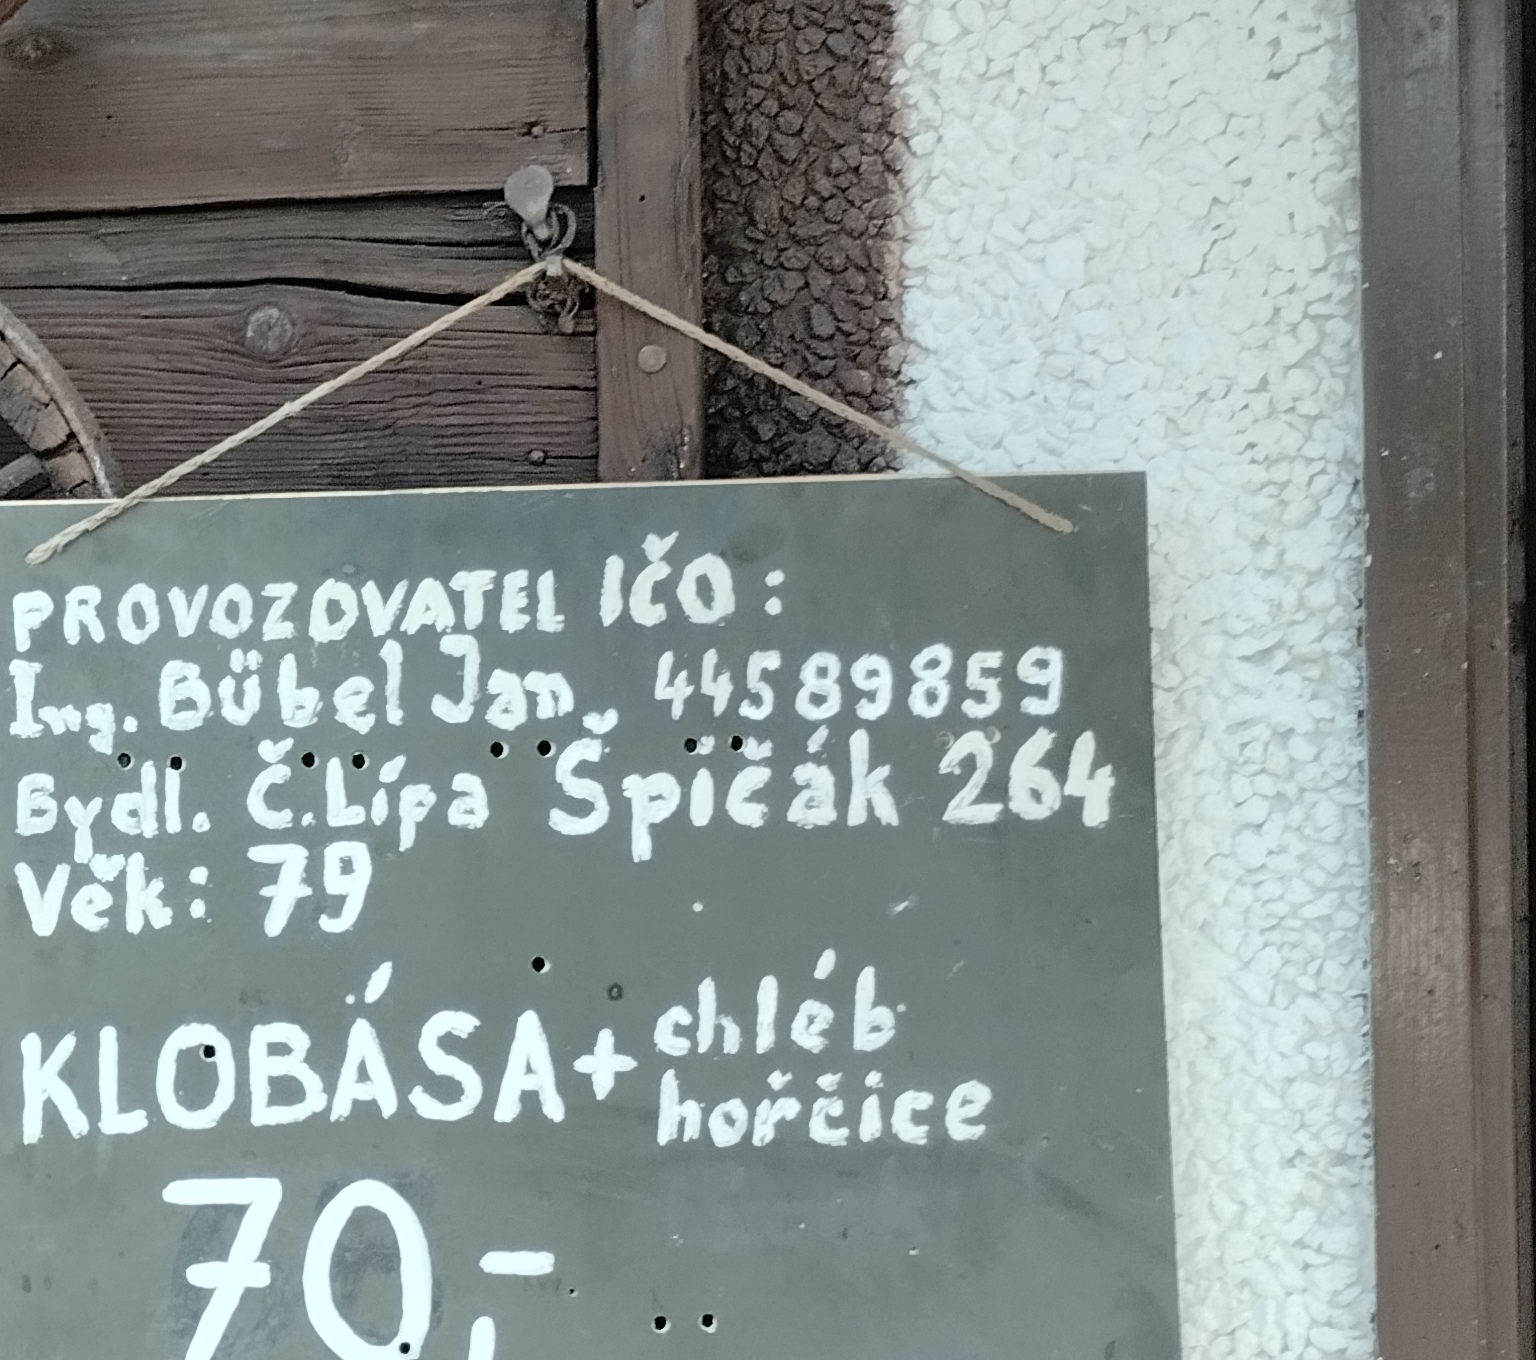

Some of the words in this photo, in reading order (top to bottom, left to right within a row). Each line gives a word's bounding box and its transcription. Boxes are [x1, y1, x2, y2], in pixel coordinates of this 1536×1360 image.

[11, 568, 566, 652] PROVOZOVATEL
[8, 658, 139, 756] Ing.
[157, 638, 406, 736] Bübel
[430, 634, 575, 732] Jan
[14, 758, 212, 864] Bydl.
[546, 707, 901, 864] Špičák
[938, 726, 1117, 828] 264
[13, 851, 212, 938] Věk:
[246, 840, 374, 938] 79
[652, 947, 897, 1056] chléb
[656, 1068, 993, 1148] hořčice
